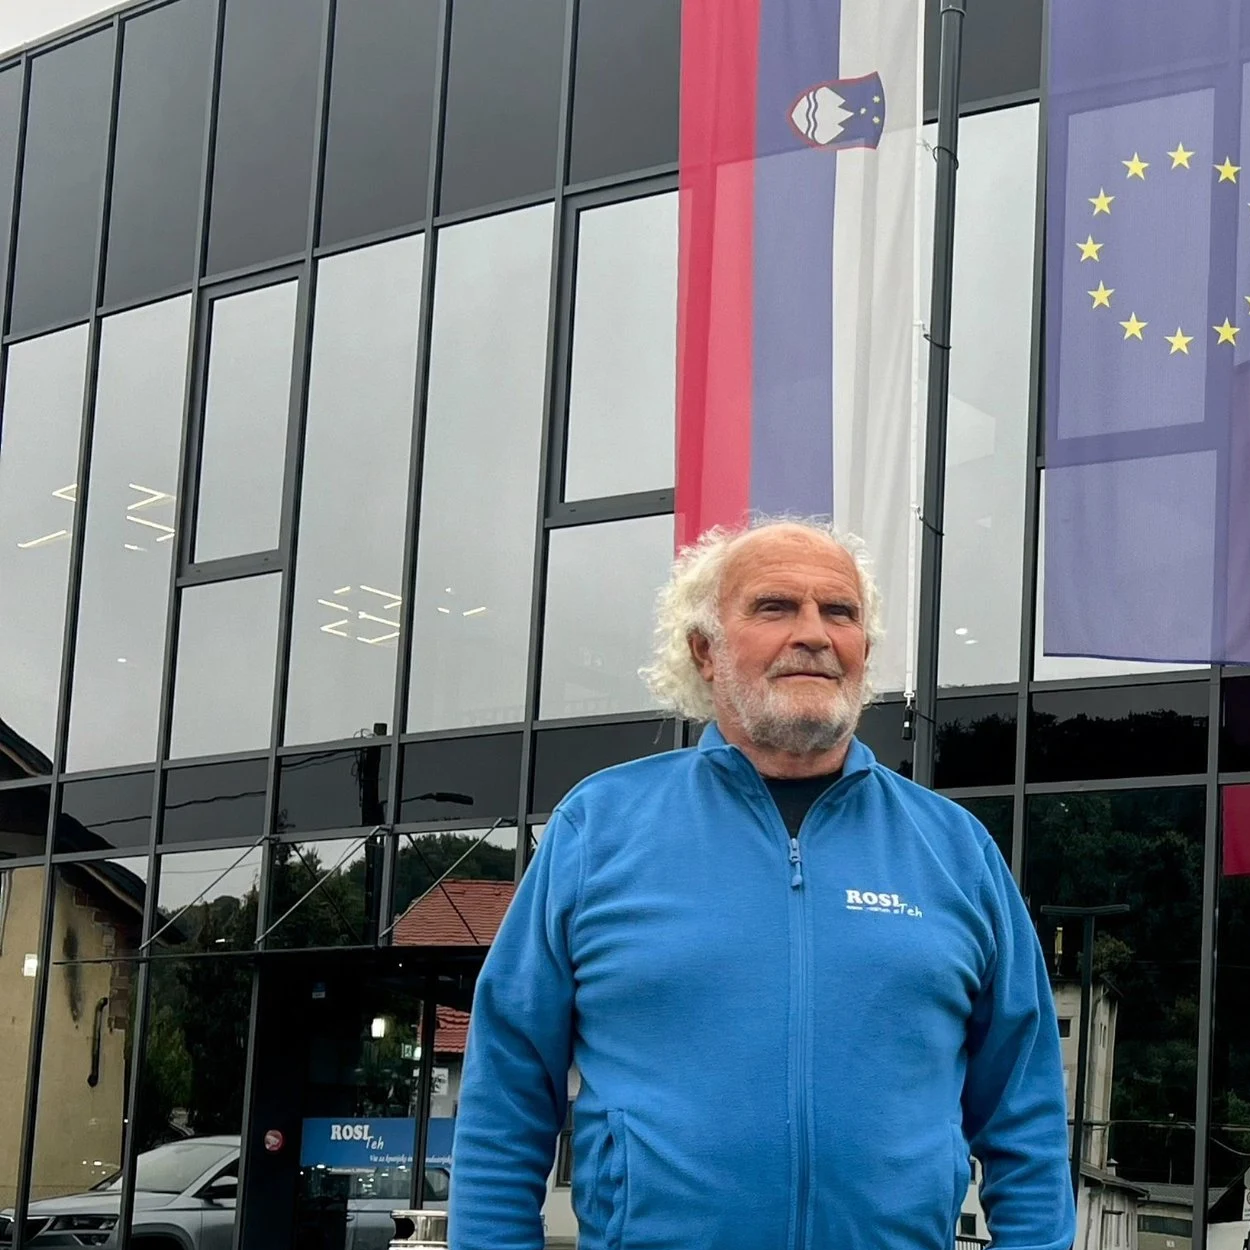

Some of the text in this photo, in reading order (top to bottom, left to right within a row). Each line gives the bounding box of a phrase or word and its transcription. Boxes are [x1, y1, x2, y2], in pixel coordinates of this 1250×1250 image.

[899, 903, 923, 918] Teh
[331, 1124, 369, 1140] ROSI
[366, 1136, 384, 1150] Teh
